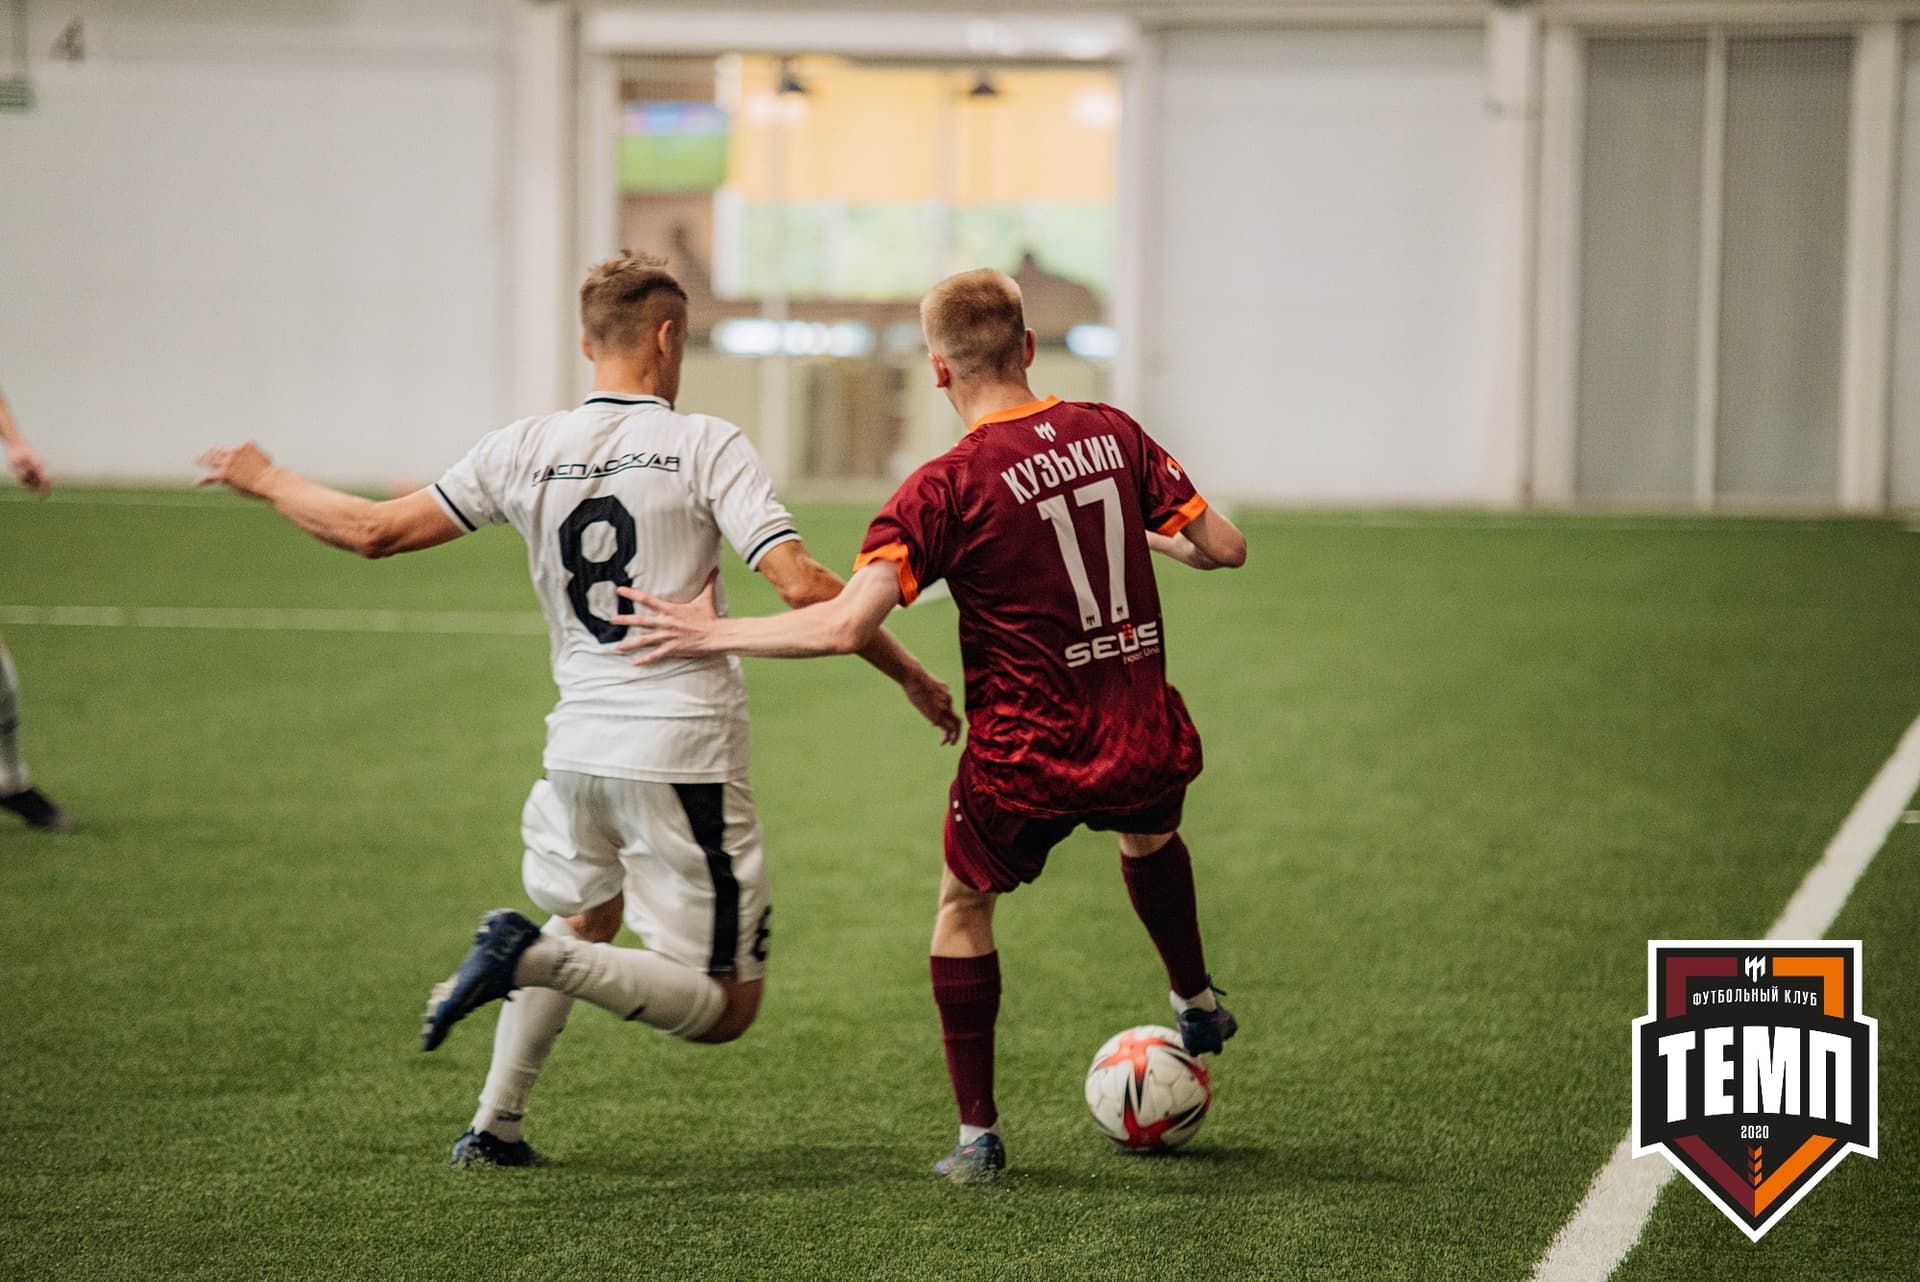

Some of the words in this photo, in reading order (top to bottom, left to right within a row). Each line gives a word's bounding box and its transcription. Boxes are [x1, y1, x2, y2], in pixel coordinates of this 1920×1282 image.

[1001, 434, 1124, 504] КУЗЬКИН
[558, 495, 636, 643] 8
[1036, 477, 1130, 632] 17
[1064, 621, 1159, 668] SEUS
